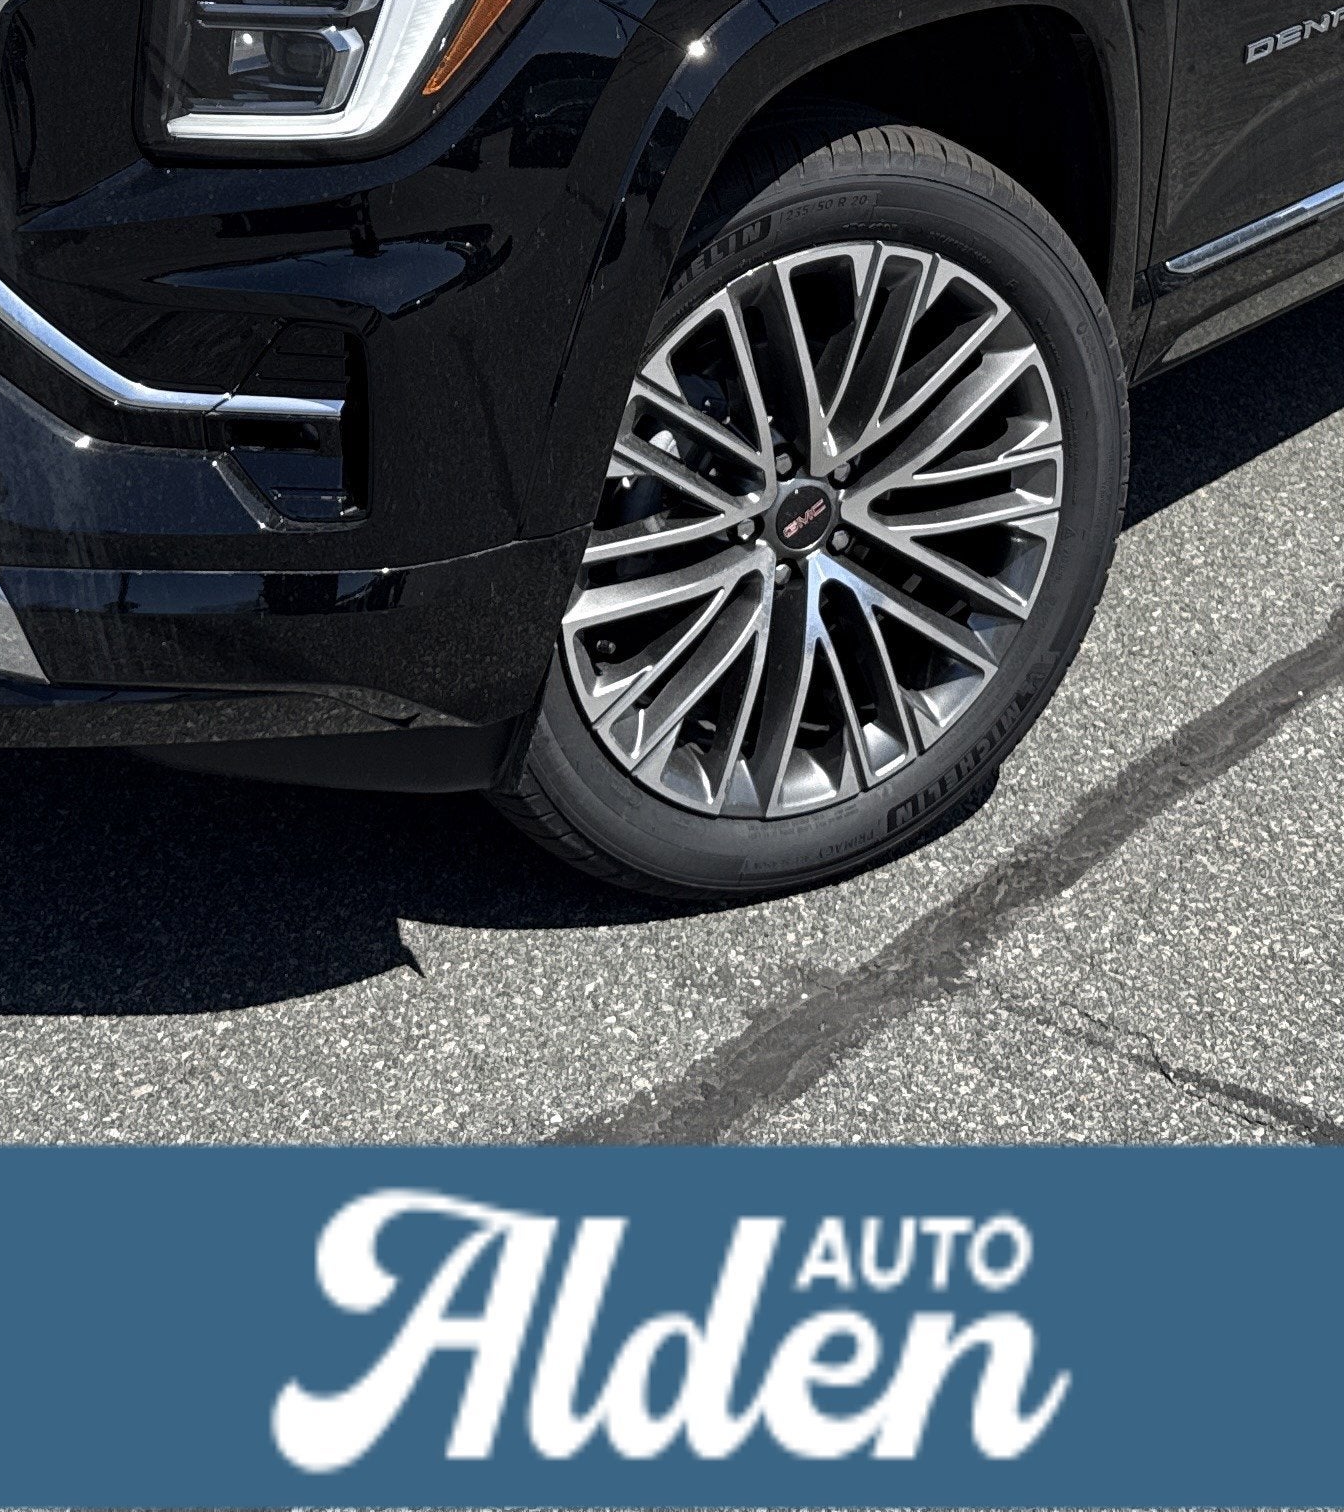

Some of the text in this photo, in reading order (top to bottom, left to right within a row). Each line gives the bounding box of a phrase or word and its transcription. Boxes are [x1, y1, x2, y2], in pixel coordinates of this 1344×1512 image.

[782, 497, 827, 539] GMC
[893, 698, 1023, 829] MICHELIN
[816, 828, 875, 859] PRIMACY
